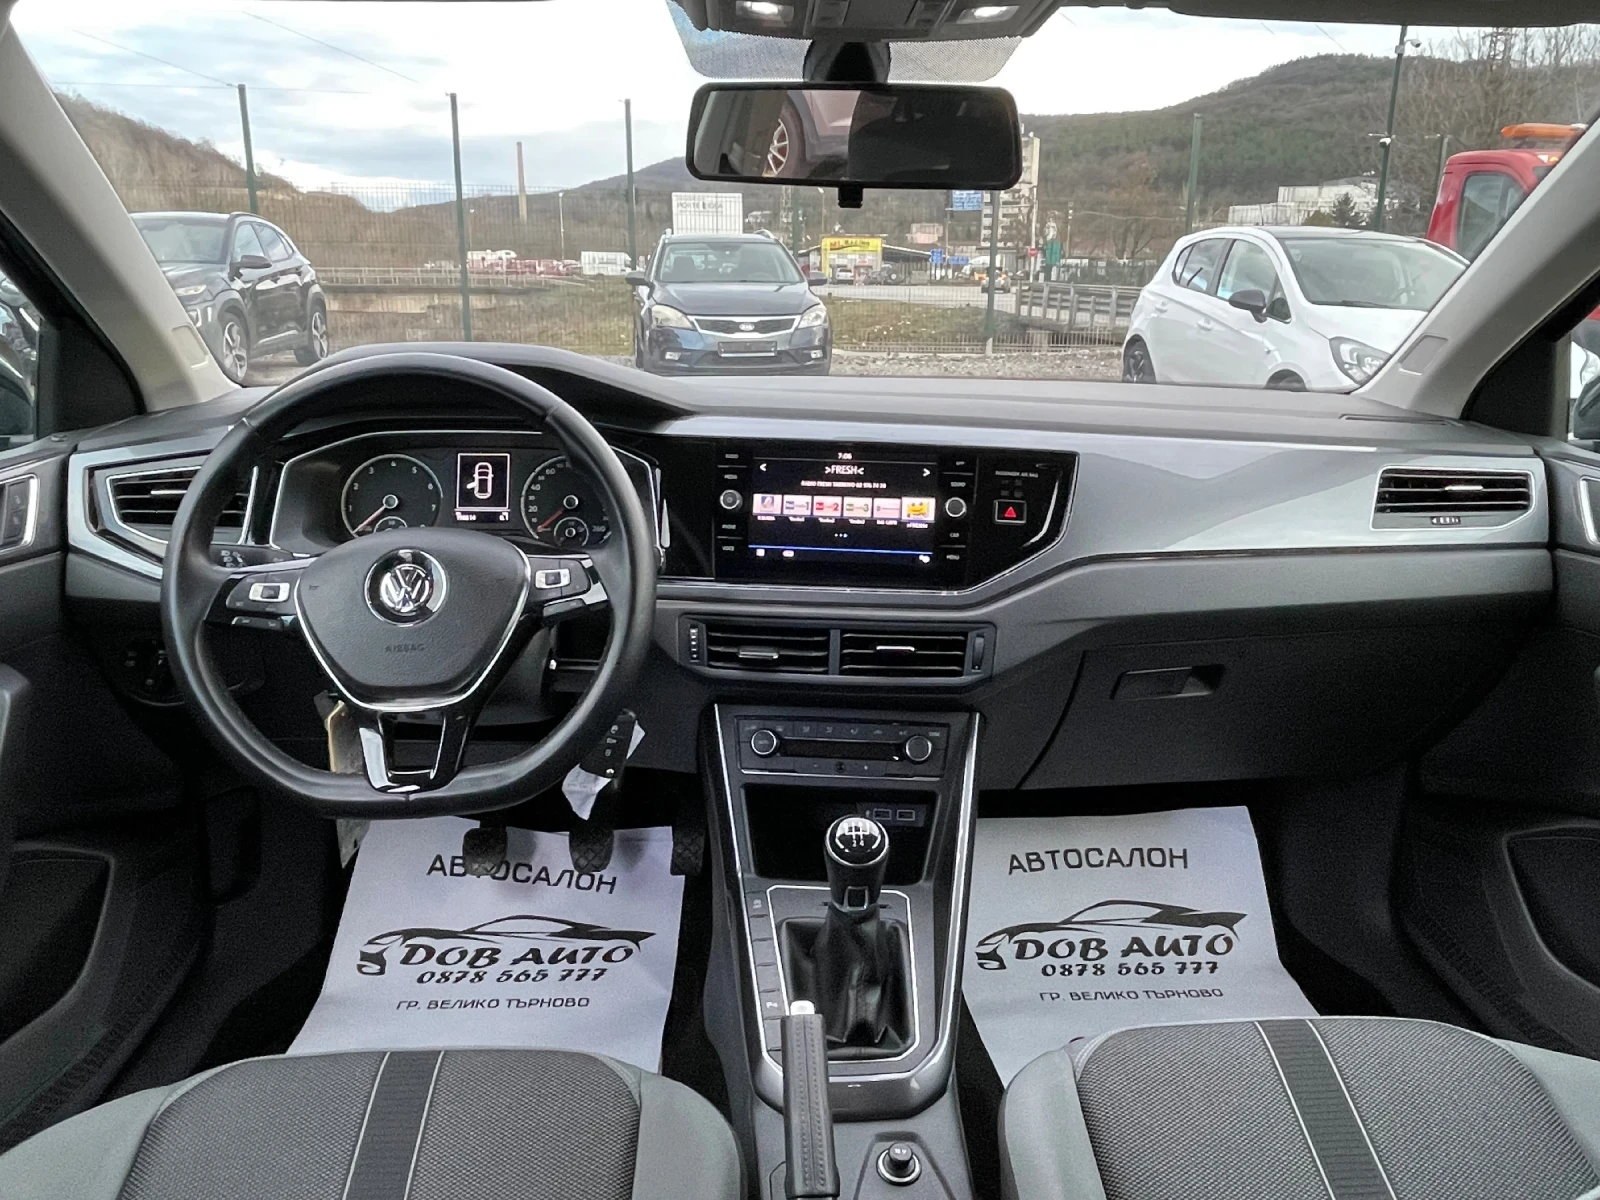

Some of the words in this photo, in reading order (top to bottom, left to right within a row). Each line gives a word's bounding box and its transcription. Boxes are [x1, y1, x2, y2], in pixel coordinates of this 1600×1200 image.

[1008, 847, 1189, 875] АВТОСАЛОН
[426, 854, 617, 894] АВОСАЛОН
[400, 944, 502, 969] DOB
[1013, 937, 1109, 961] DOB
[416, 969, 488, 984] 0878
[495, 968, 549, 983] 565
[557, 968, 608, 982] 777
[1040, 962, 1106, 977] 0878
[1117, 961, 1166, 976] 565
[1174, 961, 1219, 974] 777
[396, 999, 422, 1011] ГР.
[426, 998, 500, 1010] ВЕЛИКО
[506, 997, 591, 1009] ТЪРНОВО
[1039, 992, 1066, 1002] ГР.
[1070, 990, 1139, 1001] ВЕЛИКО
[1142, 988, 1225, 1000] ТЪРНОВО
